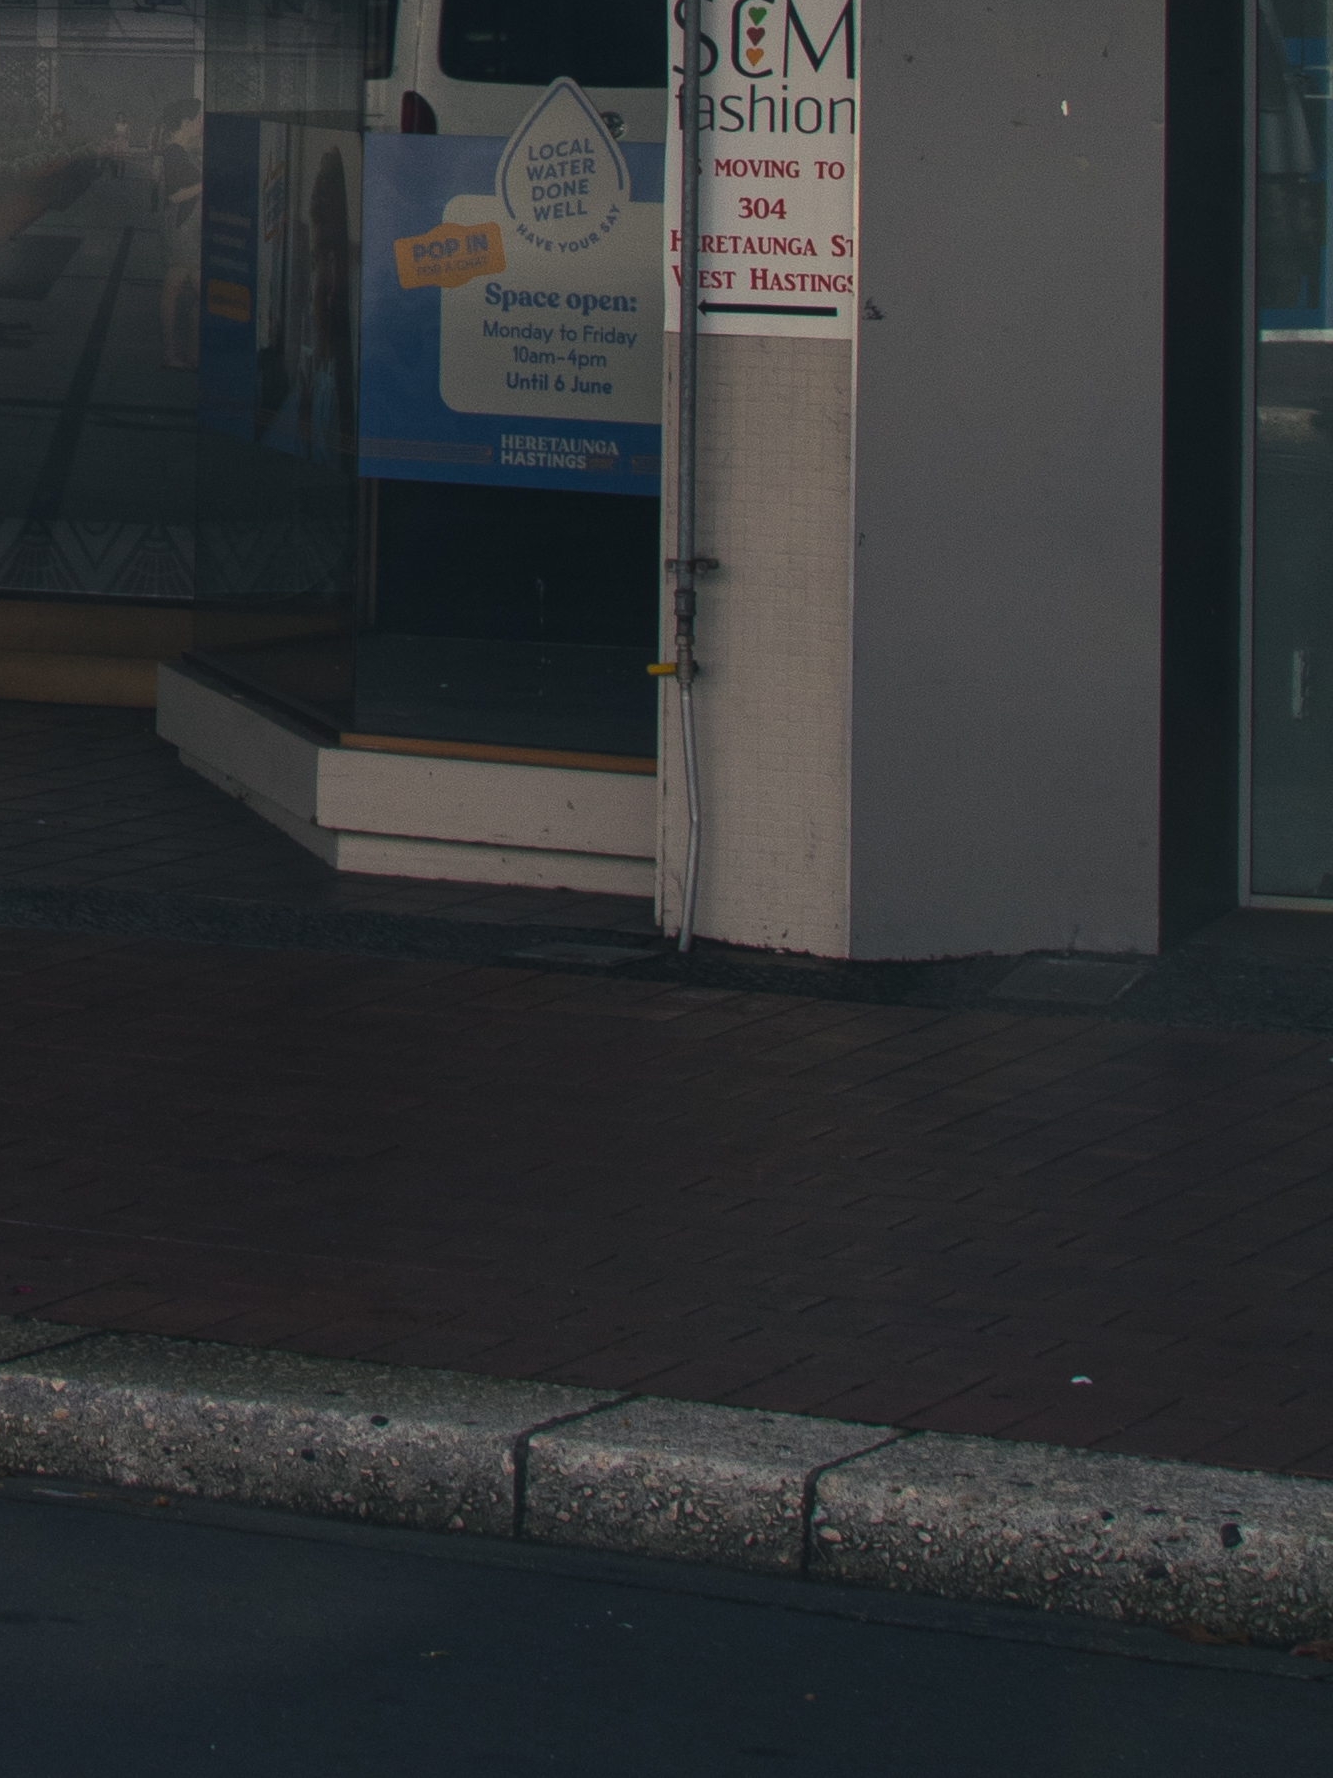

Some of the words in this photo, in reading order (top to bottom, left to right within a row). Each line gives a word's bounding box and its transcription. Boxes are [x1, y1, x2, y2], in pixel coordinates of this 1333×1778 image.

[528, 137, 595, 162] LOCAL
[526, 157, 596, 181] WATER
[714, 157, 801, 179] MOVING
[814, 160, 846, 180] TO
[531, 178, 589, 202] DONE
[533, 200, 589, 222] WELL
[738, 197, 787, 220] 304
[516, 223, 552, 253] HAVE
[558, 232, 601, 254] YOUR
[600, 203, 621, 234] SAY
[412, 237, 460, 263] POP
[465, 232, 489, 254] IN
[456, 256, 489, 272] CHAT
[485, 282, 561, 312] Space
[566, 292, 638, 317] open:
[483, 319, 554, 344] Monday
[559, 324, 578, 343] to
[583, 325, 638, 349] Friday
[506, 372, 549, 391] Until
[554, 374, 566, 393] 6
[570, 375, 614, 395] June
[500, 433, 620, 457] HERETAUNGA
[500, 451, 588, 471] HASTINGS
